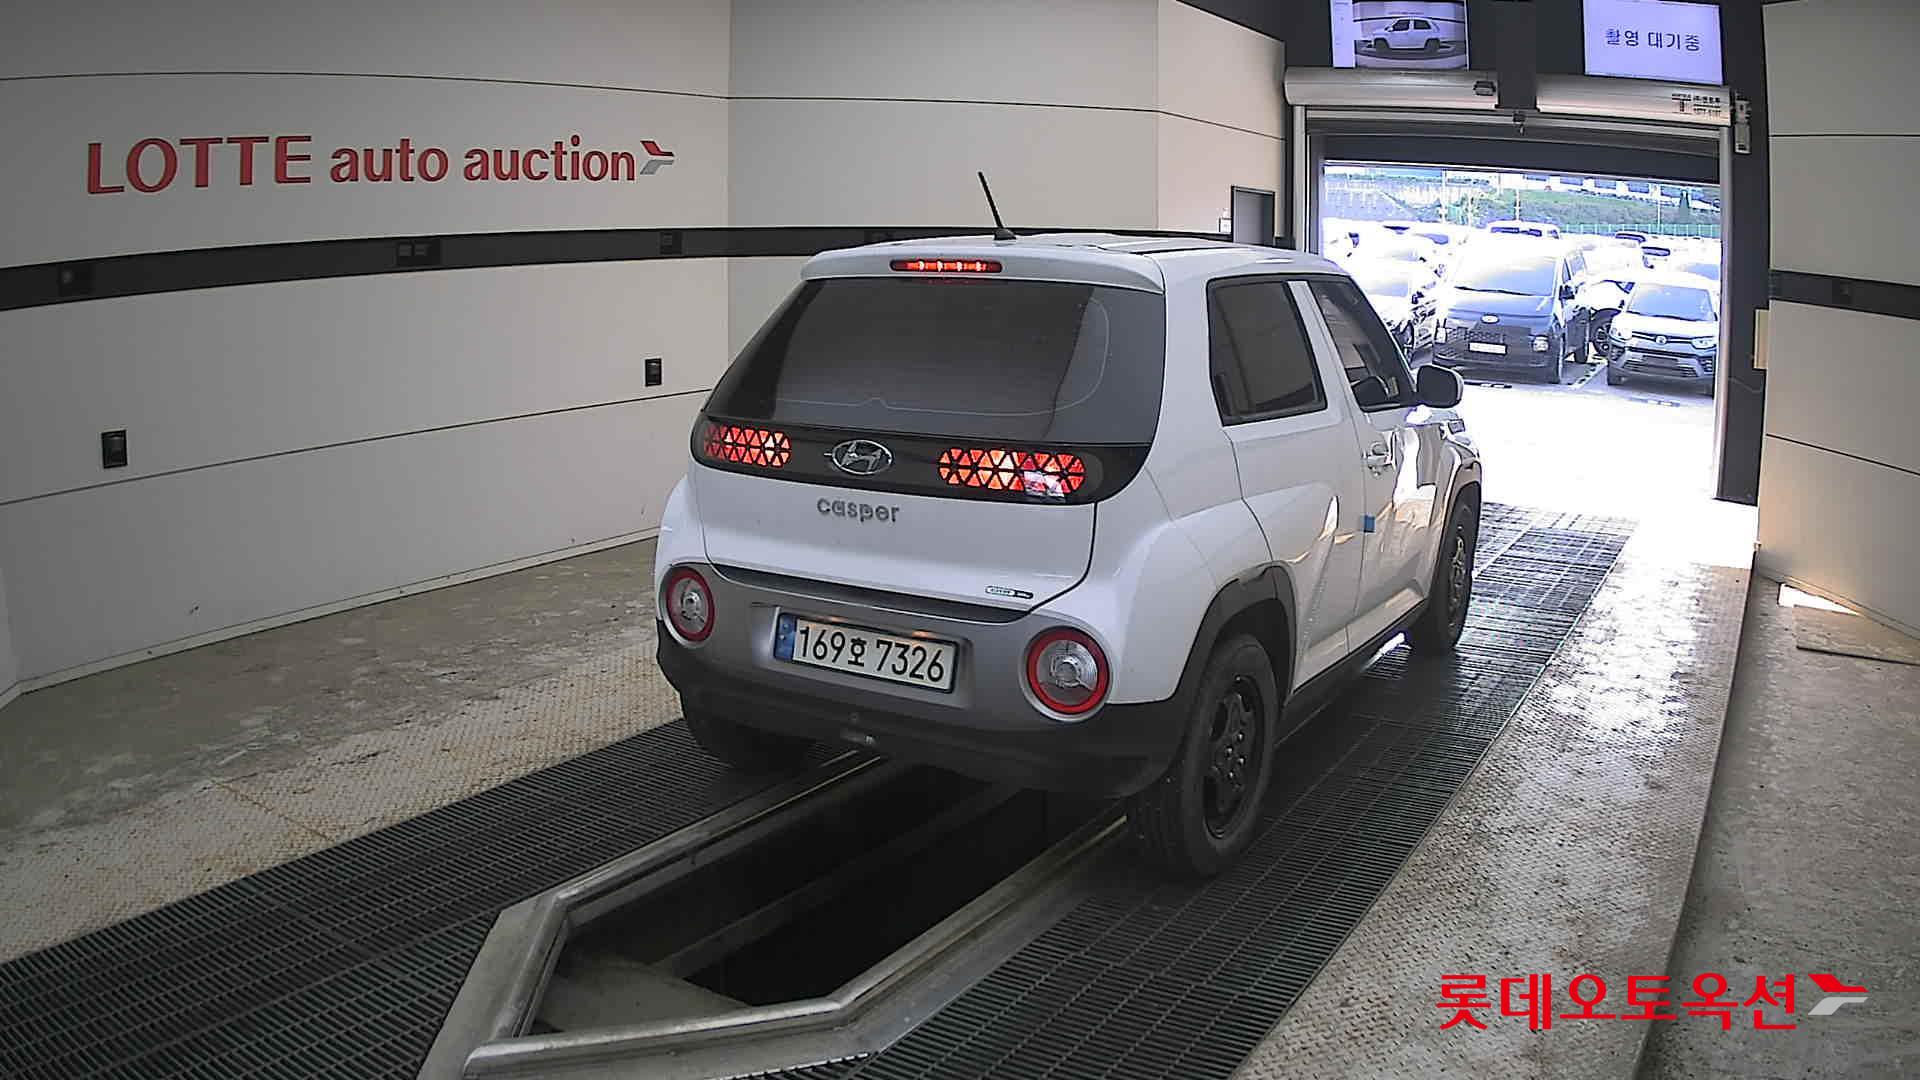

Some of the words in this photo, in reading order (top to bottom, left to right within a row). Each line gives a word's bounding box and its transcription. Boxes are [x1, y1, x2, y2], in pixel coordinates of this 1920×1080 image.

[1647, 31, 1700, 52] 대기중
[87, 135, 312, 194] LOTTE
[330, 138, 449, 182] auto
[464, 134, 635, 181] auction
[817, 498, 900, 523] casper
[799, 625, 867, 667] 169호
[875, 638, 945, 683] 7326
